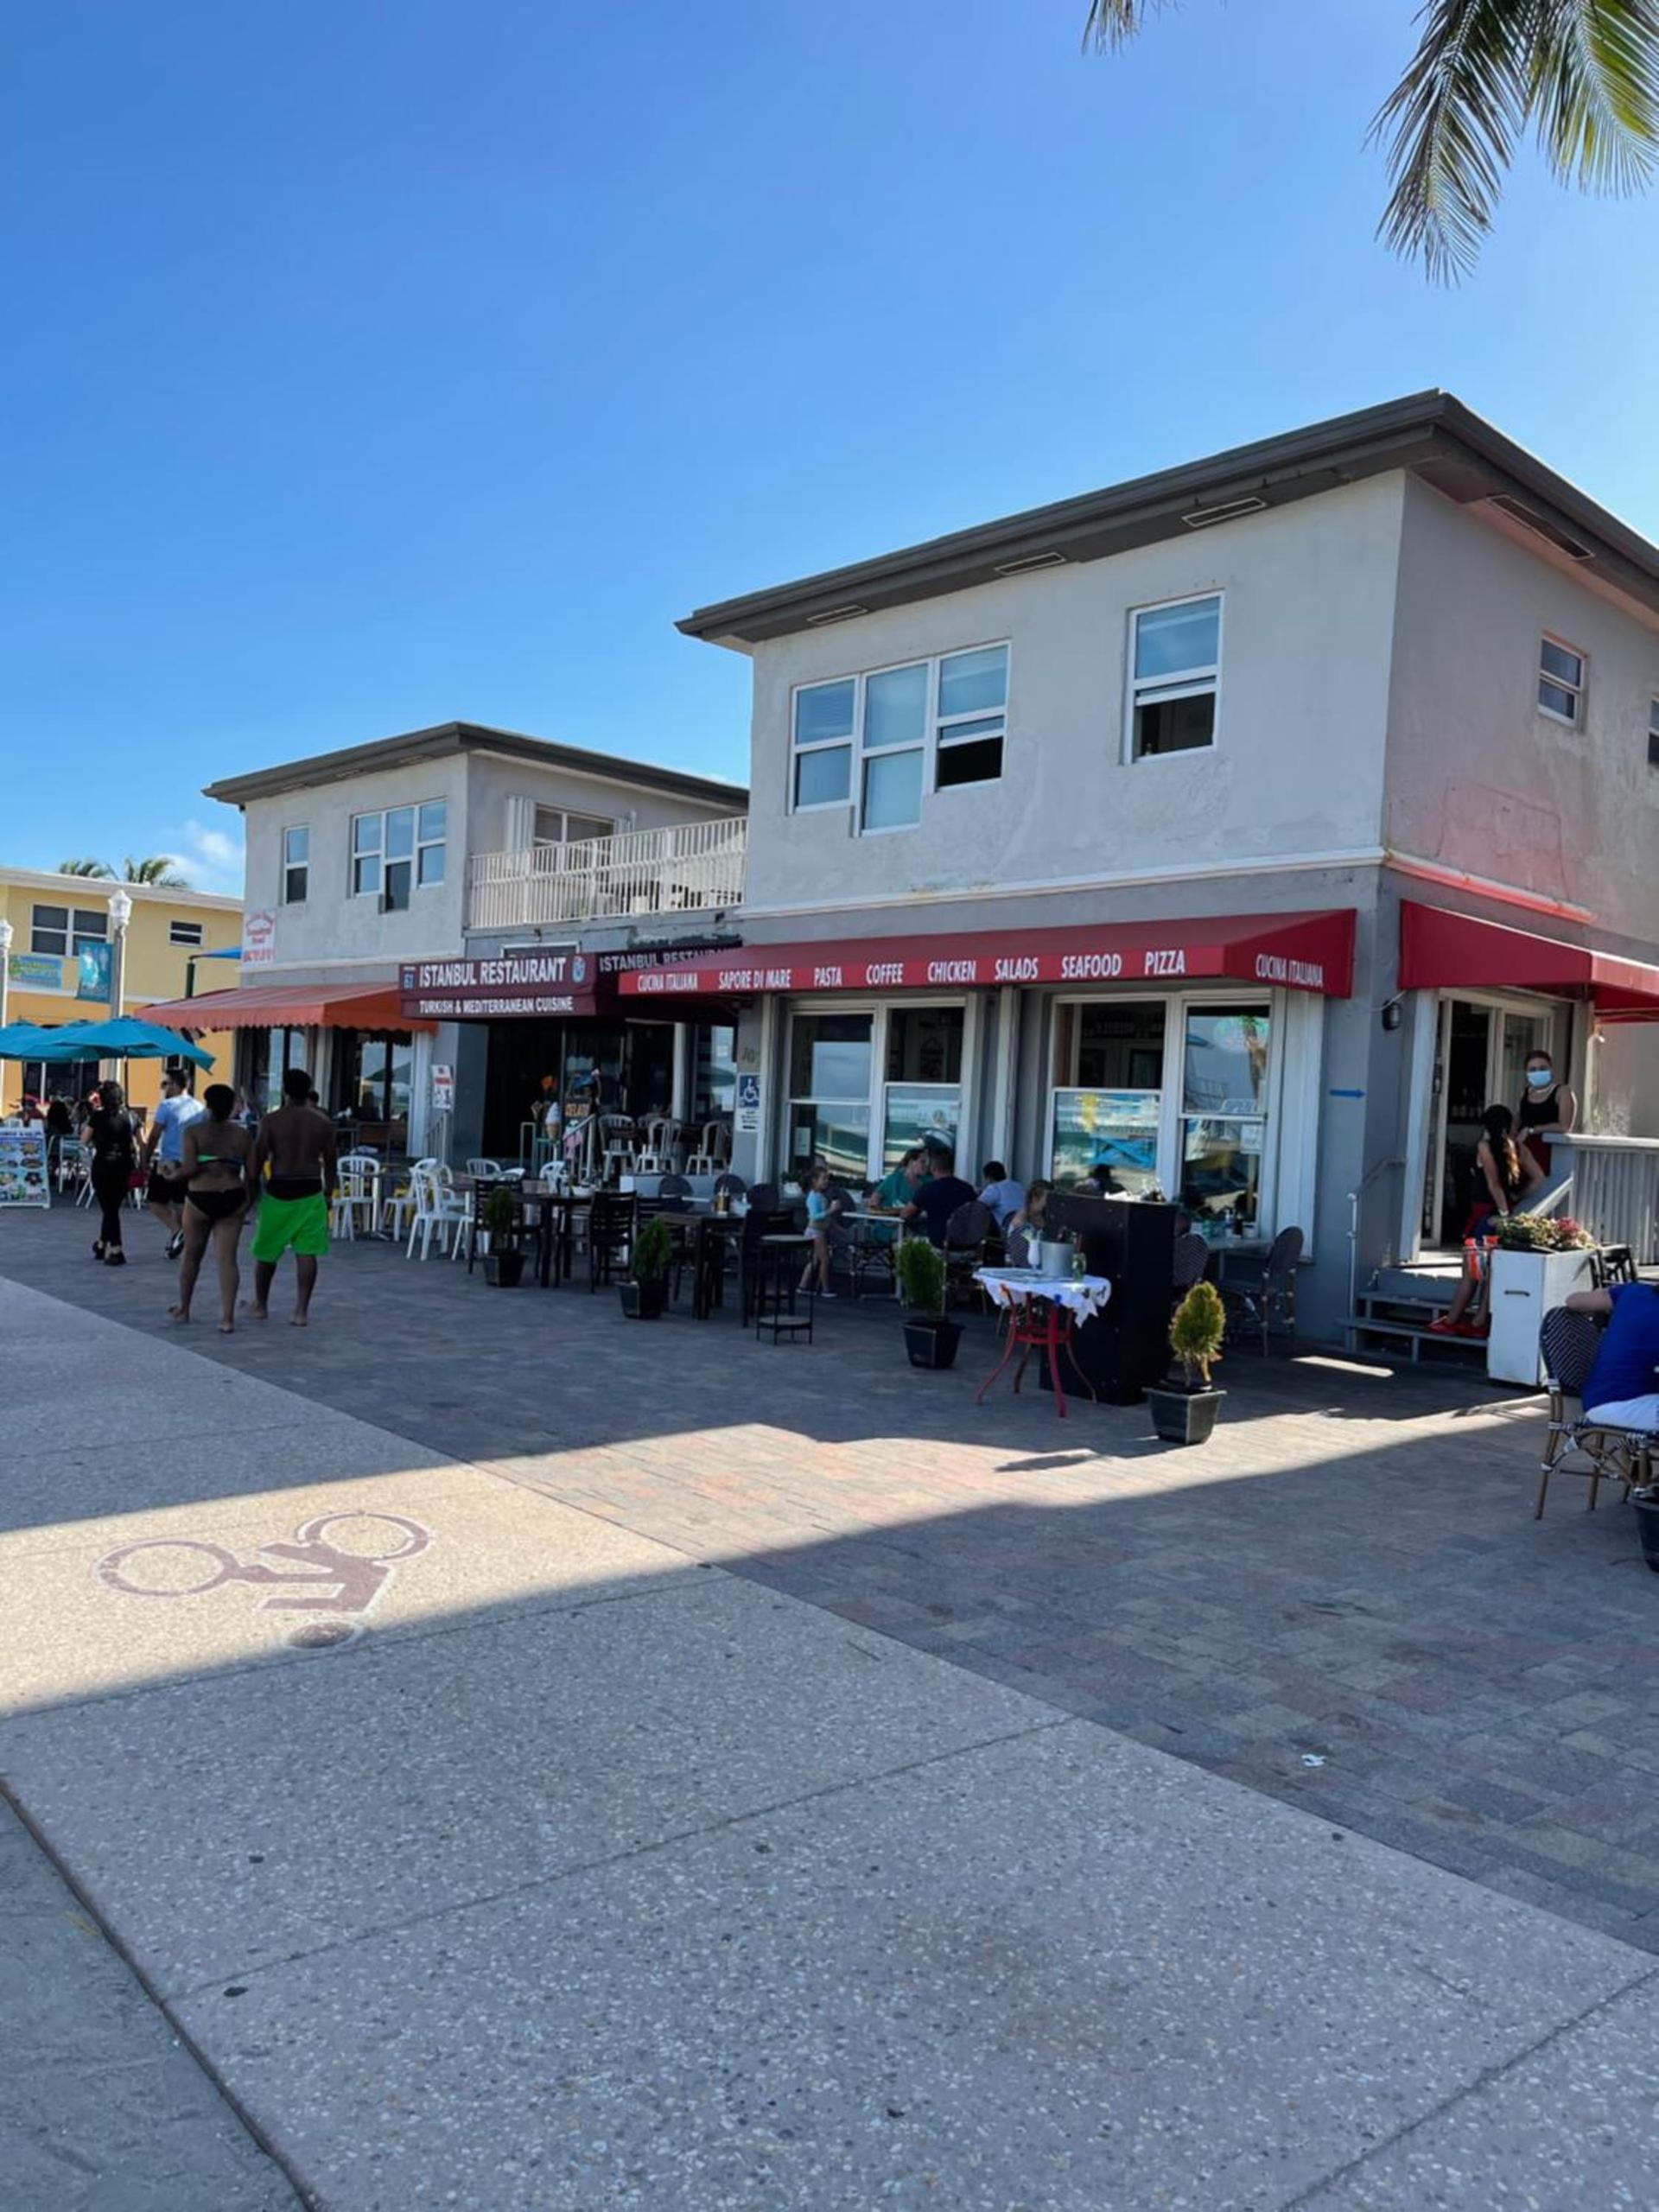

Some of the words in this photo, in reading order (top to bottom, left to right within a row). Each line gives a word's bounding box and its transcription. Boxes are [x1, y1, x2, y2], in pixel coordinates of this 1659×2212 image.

[419, 963, 477, 988] ISTANBUL
[480, 957, 566, 985] RESTAURANT
[599, 951, 660, 972] ISTANBUL
[927, 960, 976, 982] CHICKEN
[995, 957, 1039, 980] SALADS
[1061, 954, 1122, 978] SEAFOOD
[1144, 950, 1185, 975] PIZZA
[1255, 954, 1287, 980] CUCINA
[1288, 959, 1323, 988] ITALIANA
[638, 974, 664, 992] CUCINA
[665, 973, 698, 991] ITALIANA
[719, 970, 752, 989] SAPORE
[753, 969, 764, 988] DI
[766, 969, 791, 988] MARE
[814, 967, 842, 987] PASTA
[866, 963, 903, 985] COFFEE
[420, 1000, 454, 1014] TURKISH
[455, 999, 462, 1014] &
[463, 997, 534, 1014] MEDITERRANEAN
[536, 996, 574, 1012] CUISINE
